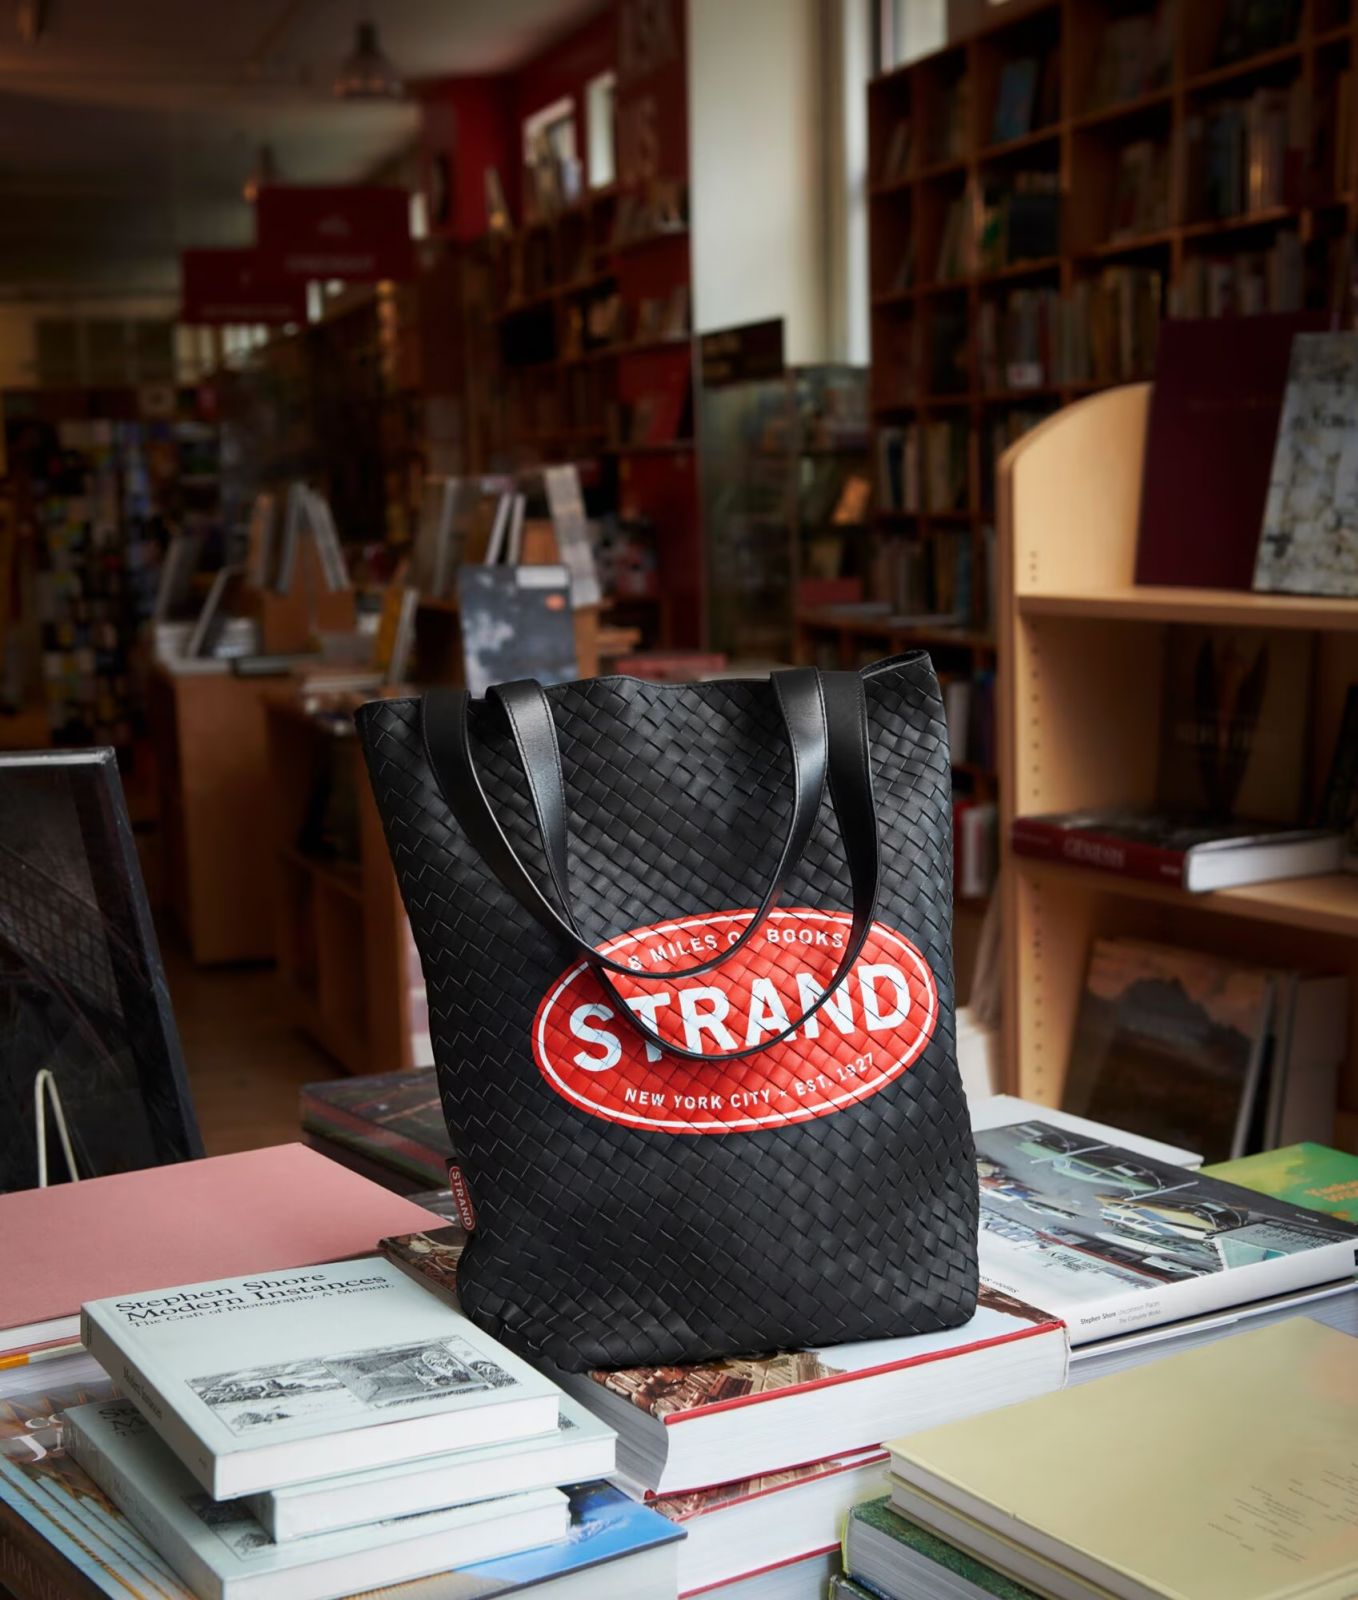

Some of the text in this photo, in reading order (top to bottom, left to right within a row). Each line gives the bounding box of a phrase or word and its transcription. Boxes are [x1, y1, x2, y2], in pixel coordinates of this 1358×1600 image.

[650, 935, 718, 963] MILES
[766, 928, 844, 949] BOOKS
[568, 963, 912, 1073] STRAND
[624, 1052, 873, 1110] NEW YORK CITY EST. 1927
[452, 1171, 472, 1225] STRAND
[115, 1274, 327, 1312] Stephen Shore
[126, 1275, 388, 1322] Modern Instances
[129, 1319, 161, 1328] The
[166, 1311, 204, 1321] Craft
[209, 1307, 222, 1315] of
[1080, 1315, 1101, 1325] Stephen
